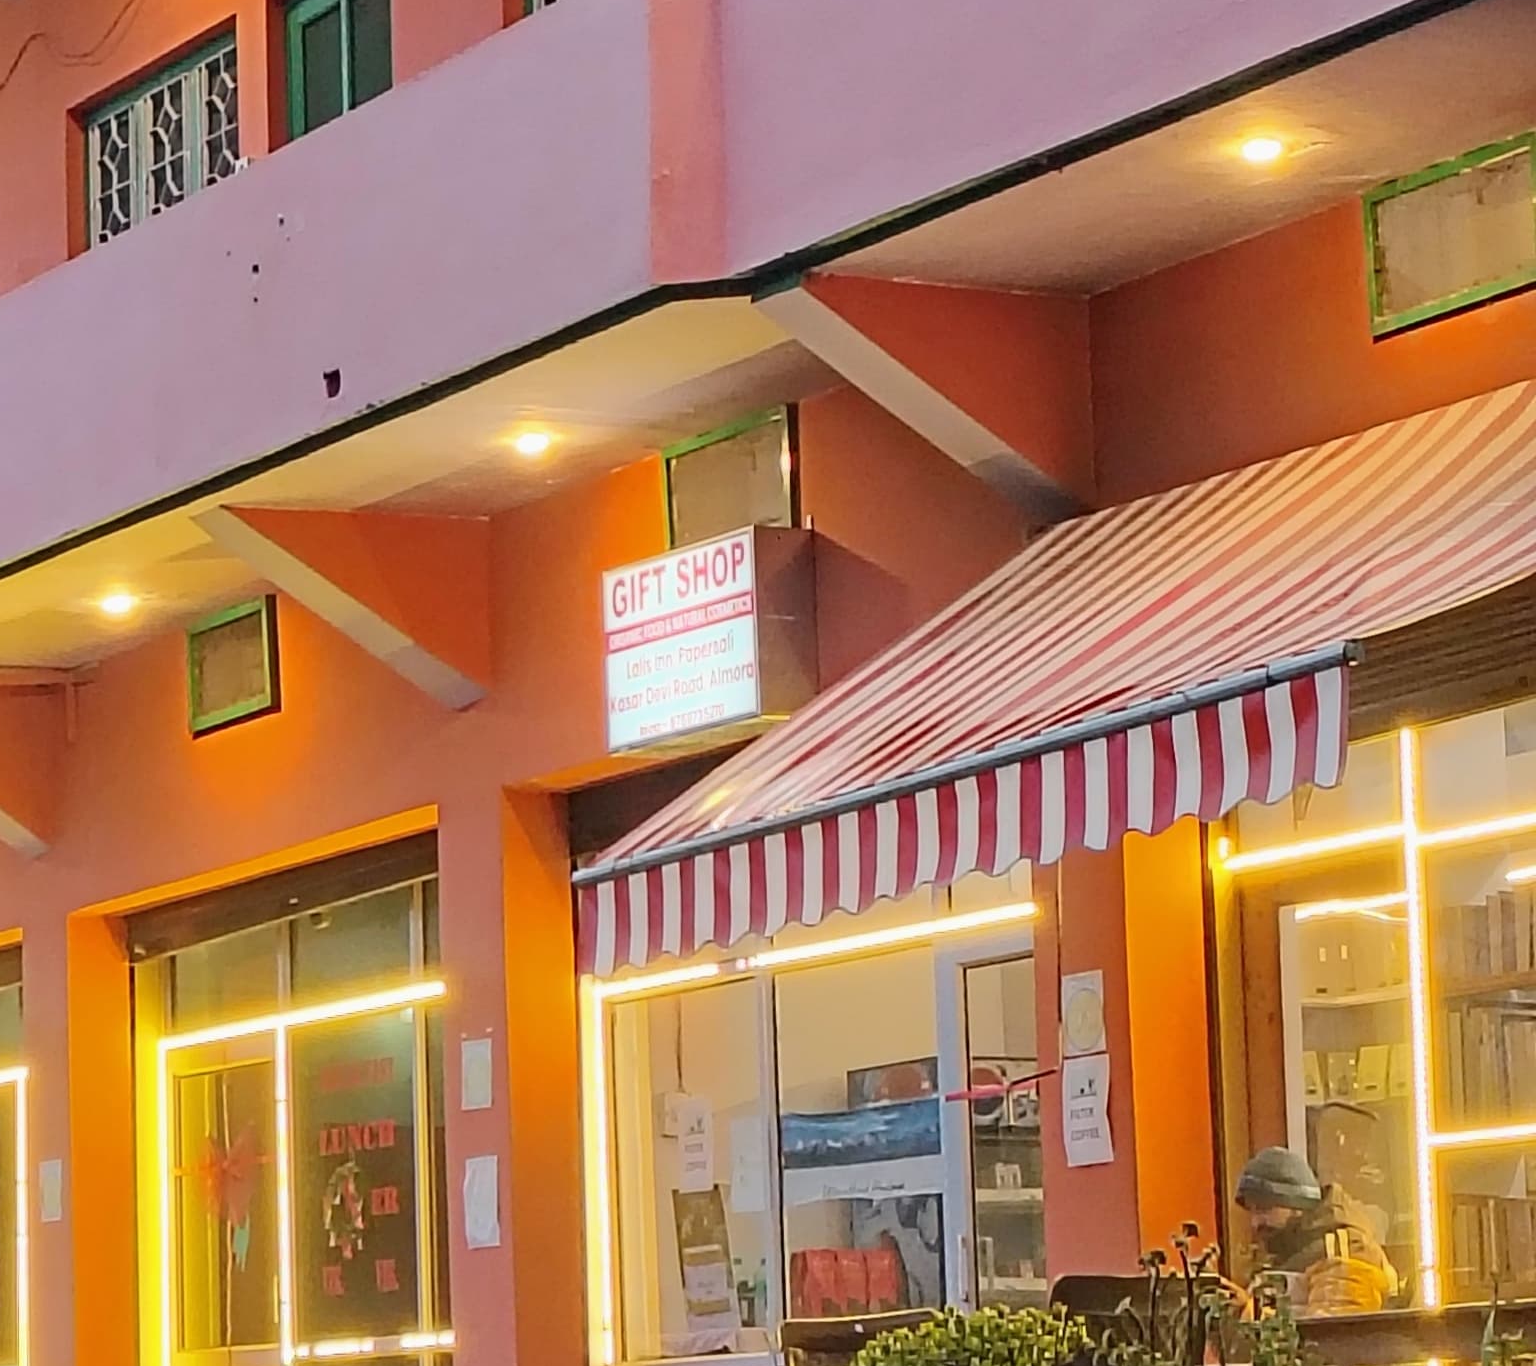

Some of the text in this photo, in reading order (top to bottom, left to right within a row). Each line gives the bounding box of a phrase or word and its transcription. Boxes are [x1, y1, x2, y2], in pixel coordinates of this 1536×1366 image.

[612, 541, 745, 618] GIFT SHOP
[319, 1119, 396, 1156] LUNCH
